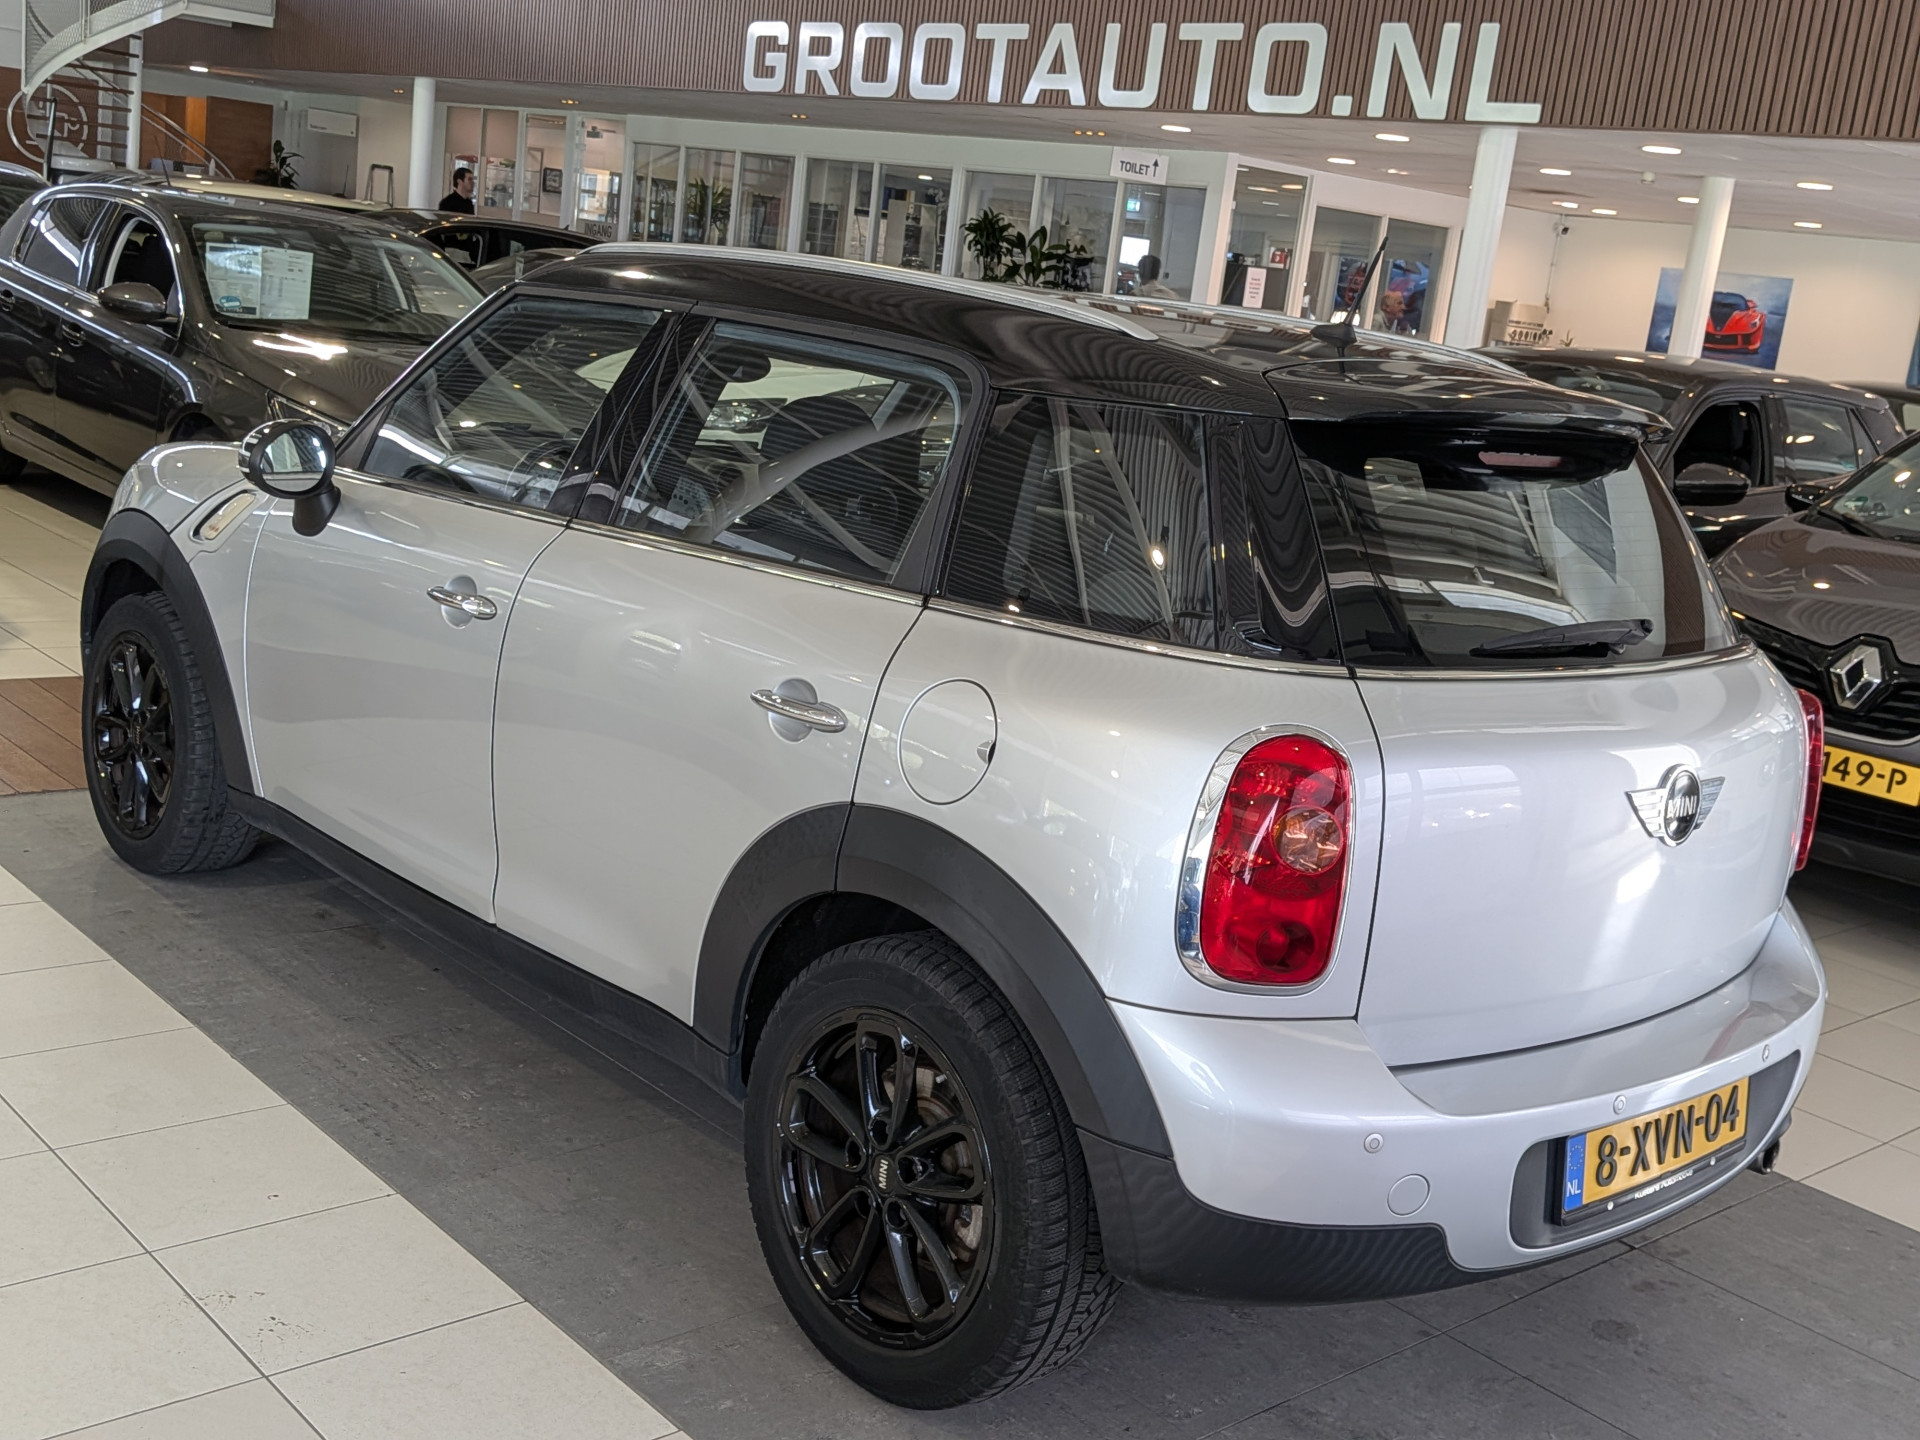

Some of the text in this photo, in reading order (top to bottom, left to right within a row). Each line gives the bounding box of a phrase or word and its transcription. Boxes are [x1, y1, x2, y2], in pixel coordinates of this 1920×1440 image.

[743, 20, 1542, 124] GROOTAUTO.NL
[1119, 160, 1151, 176] TOILET
[584, 222, 613, 238] INGANG
[1666, 795, 1698, 819] MINI
[1596, 1086, 1739, 1187] 8-XVN-04
[878, 1159, 889, 1190] MINI
[1566, 1179, 1582, 1198] NL
